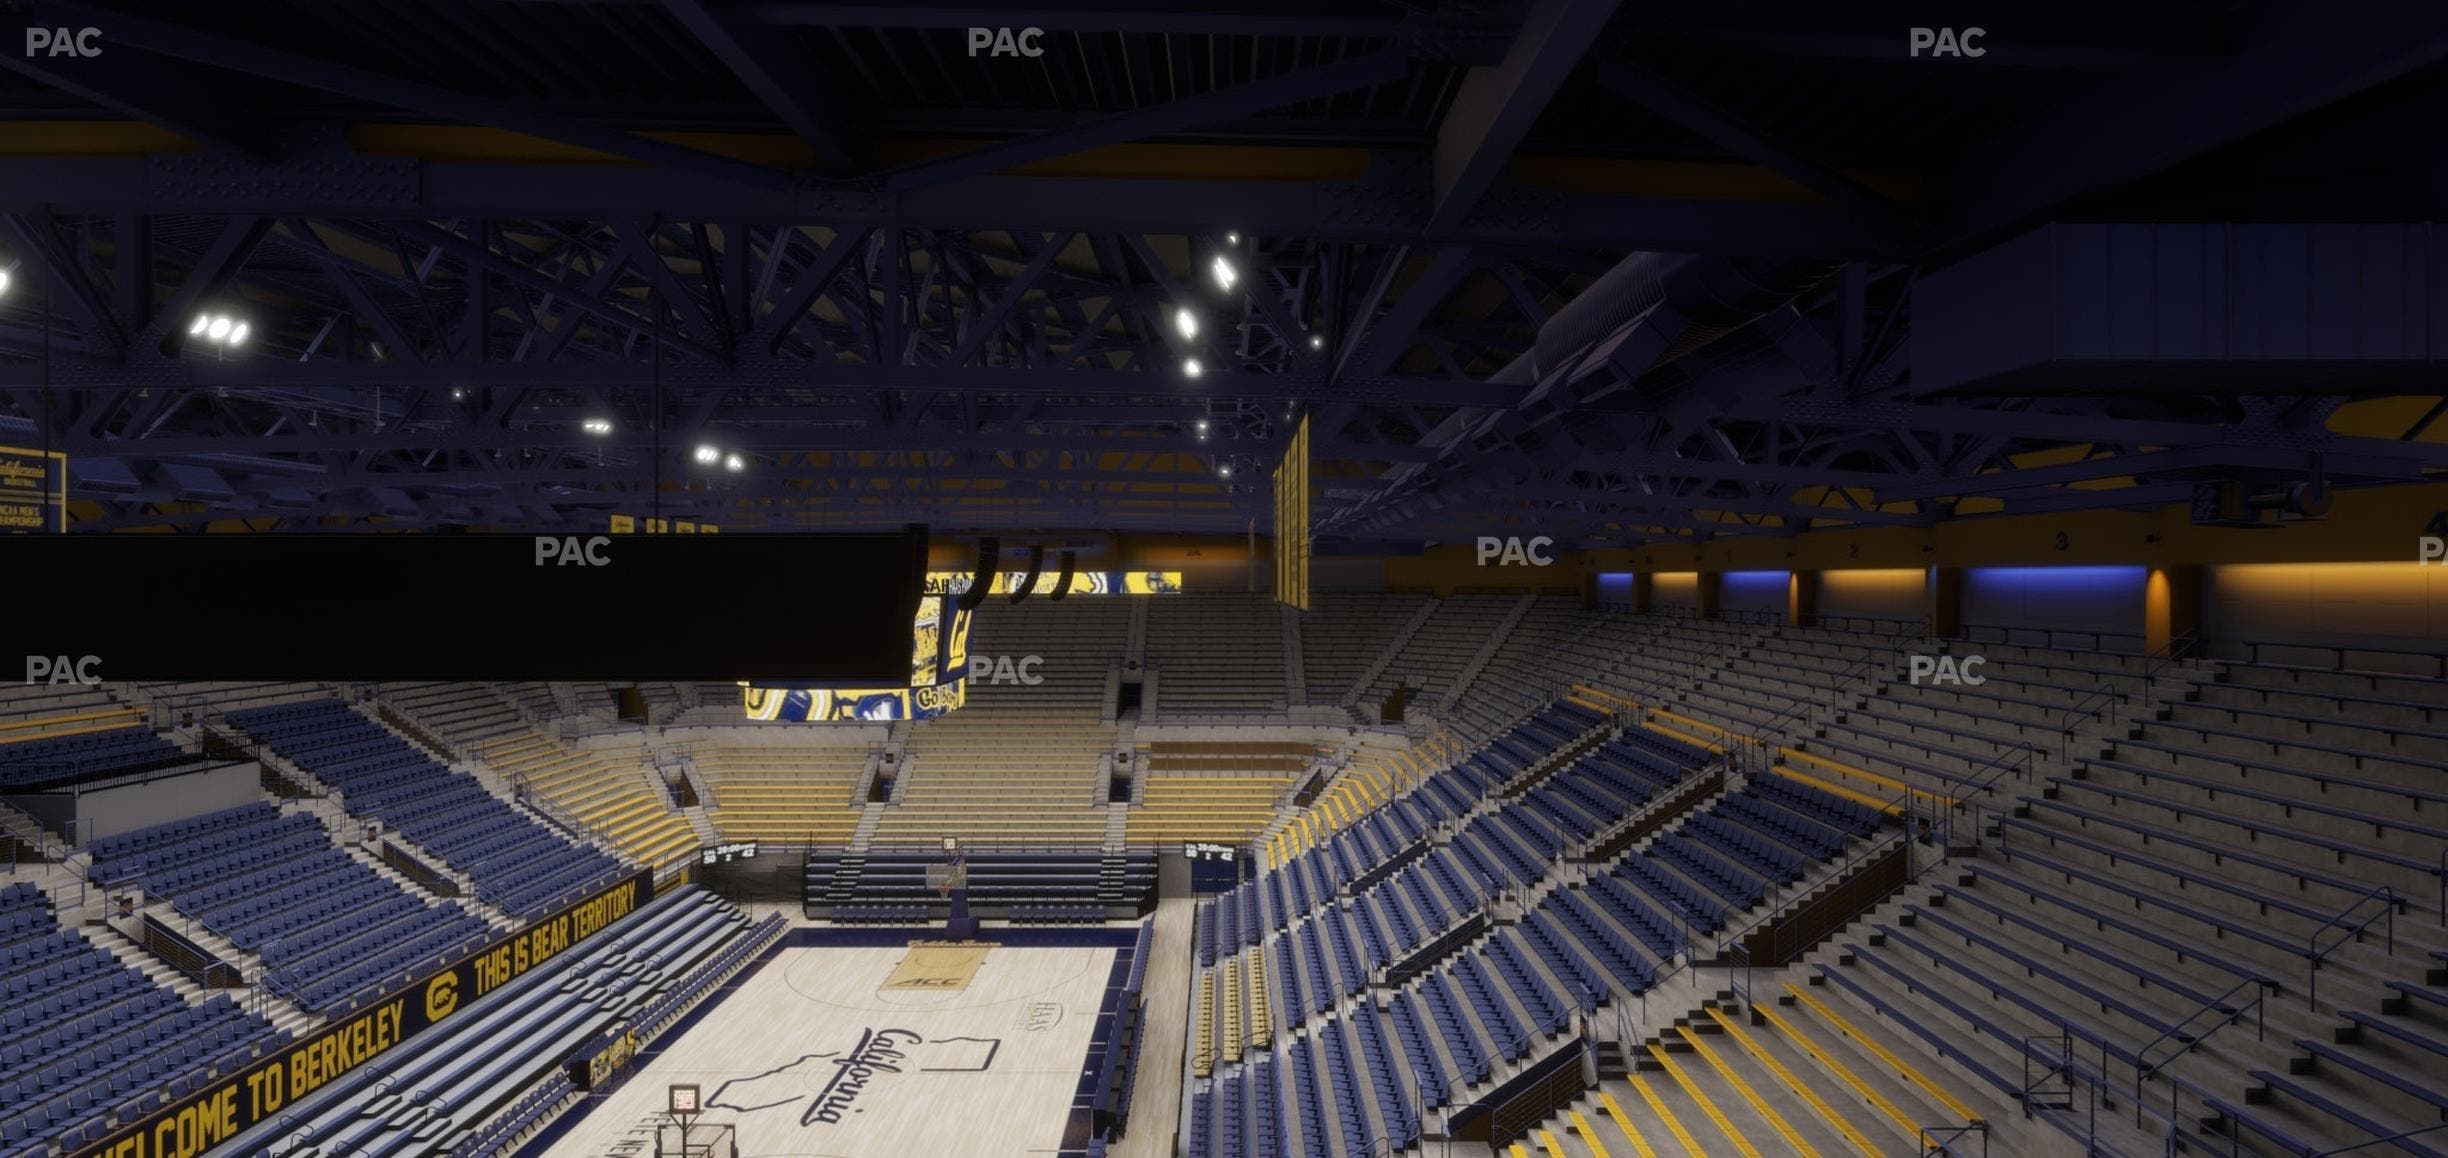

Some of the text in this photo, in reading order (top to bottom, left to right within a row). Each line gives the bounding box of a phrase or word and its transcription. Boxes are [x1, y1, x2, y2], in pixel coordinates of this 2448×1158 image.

[0, 458, 45, 477] alifornia
[2055, 531, 2069, 551] 3
[474, 879, 637, 996] THIS IS BEAR TERRITORY
[896, 977, 965, 986] ACC
[248, 1061, 283, 1122] TO
[290, 999, 404, 1101] BERKELEY
[800, 1027, 923, 1127] California
